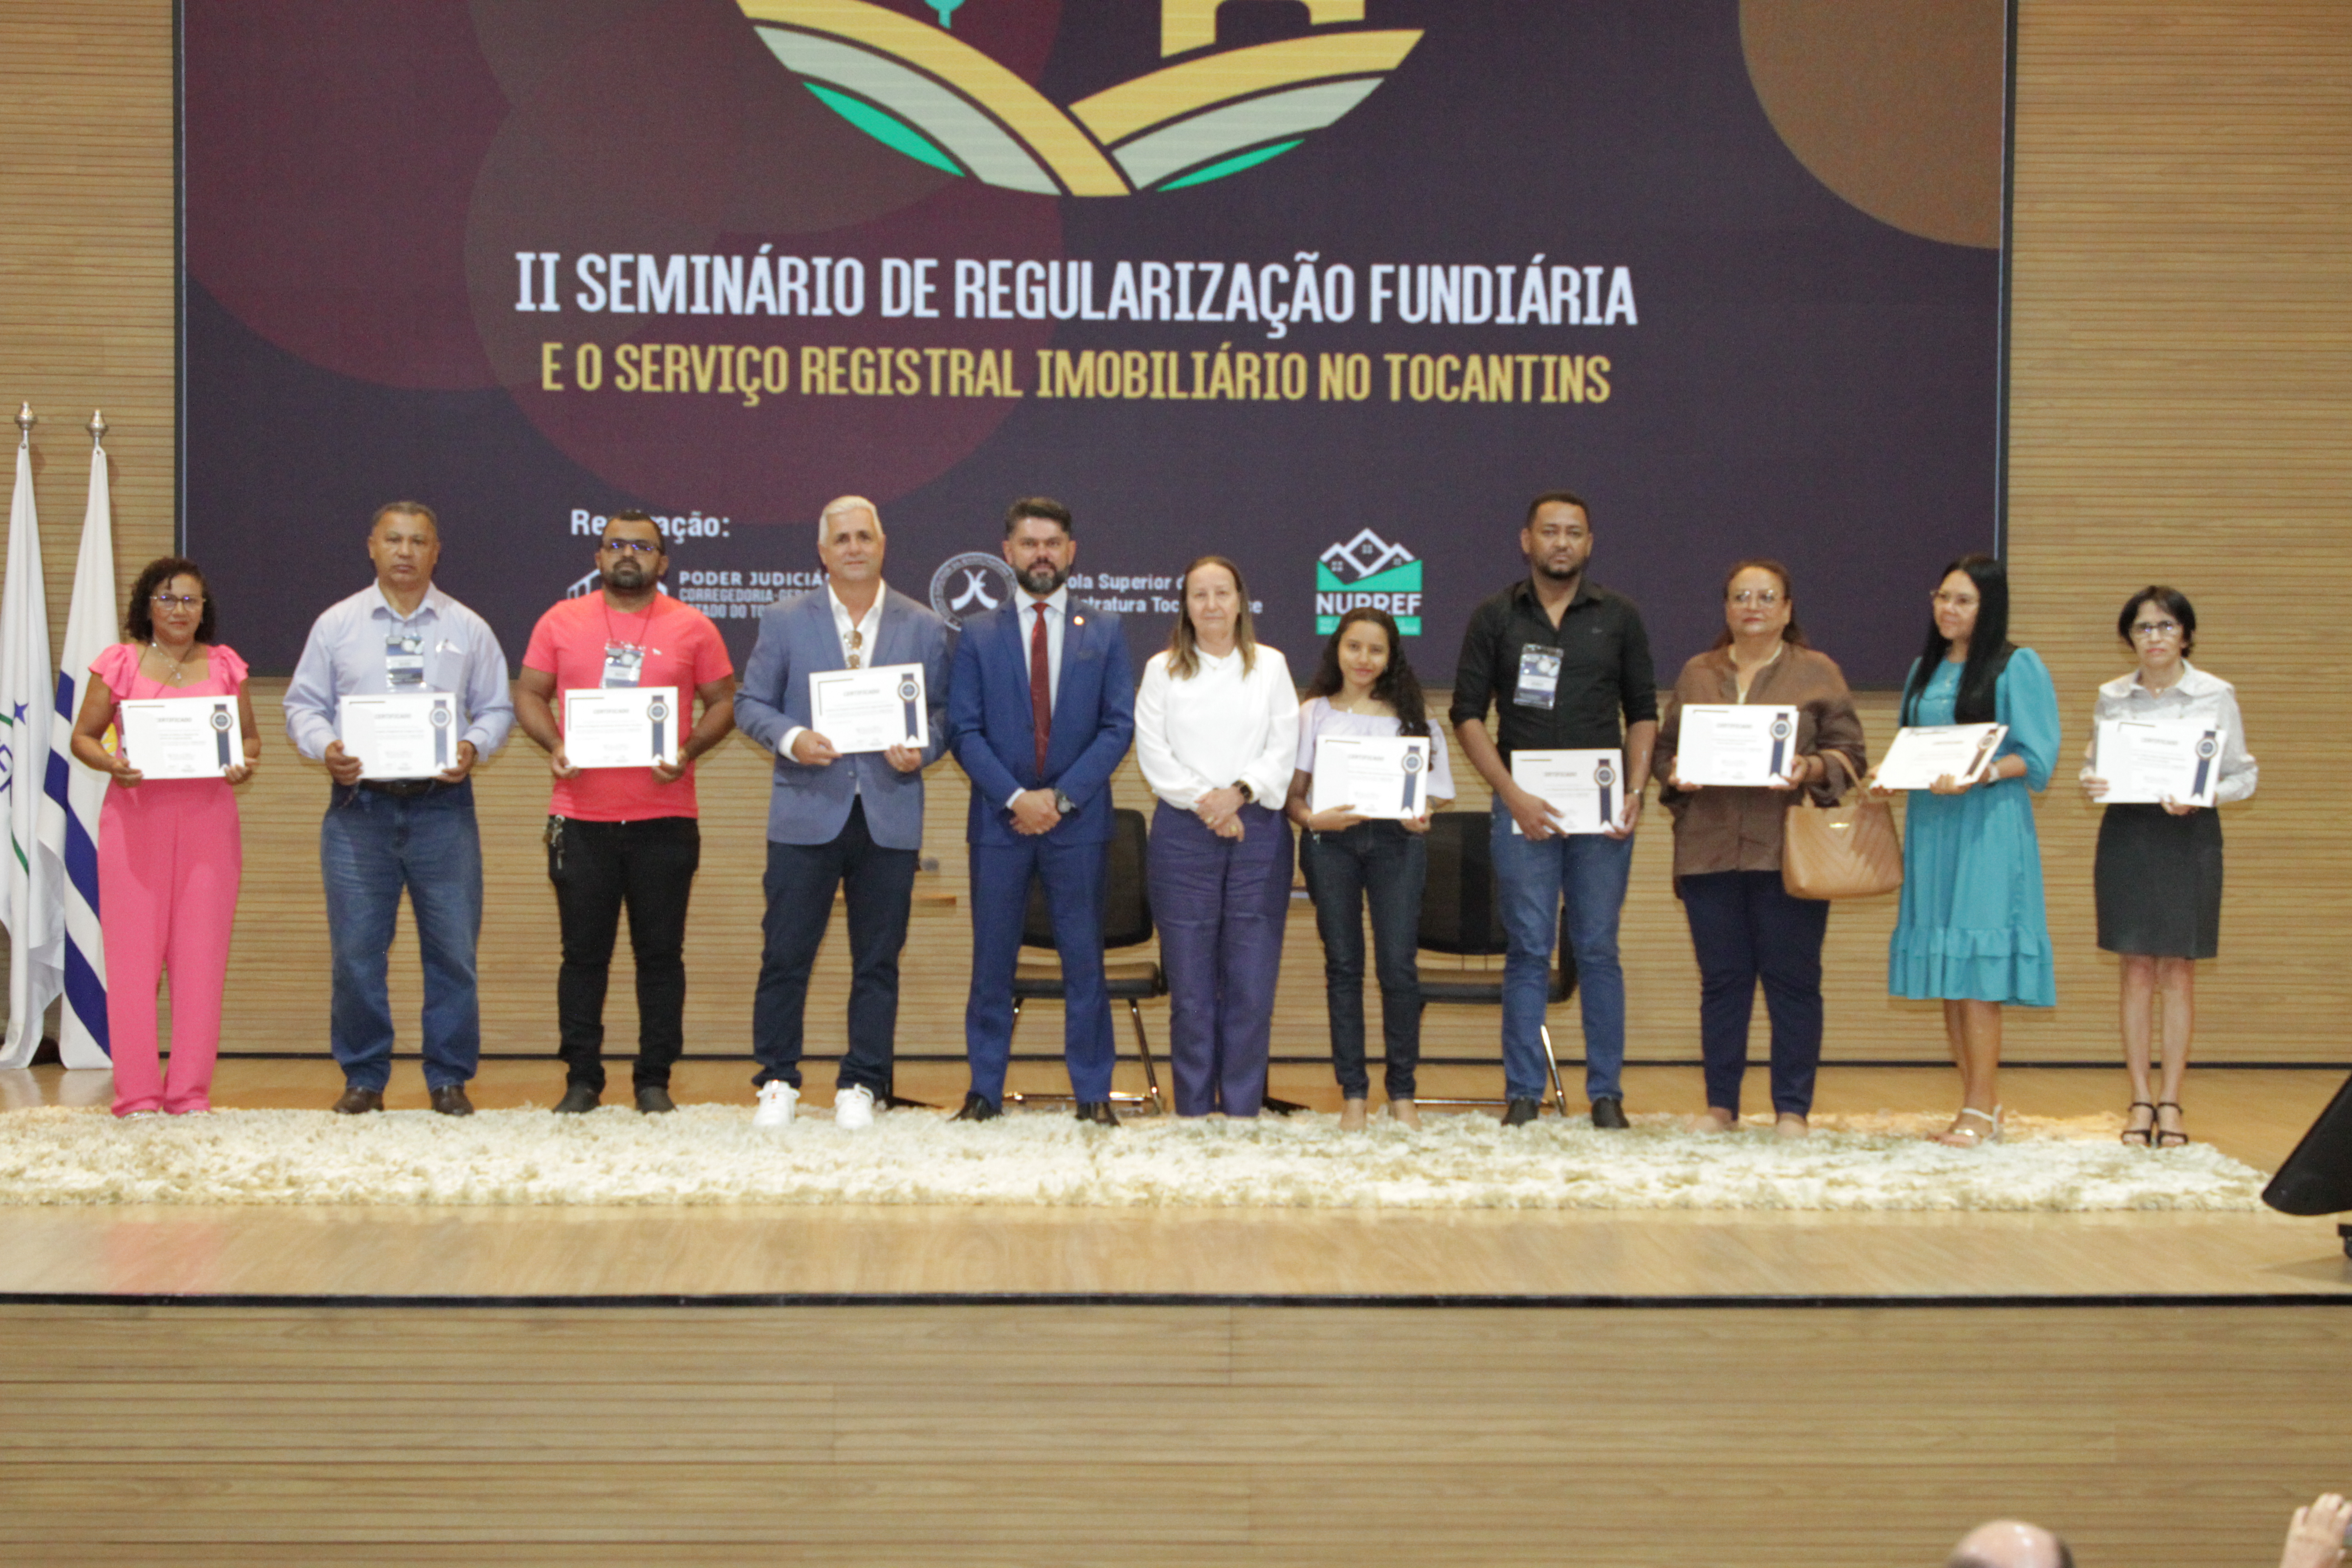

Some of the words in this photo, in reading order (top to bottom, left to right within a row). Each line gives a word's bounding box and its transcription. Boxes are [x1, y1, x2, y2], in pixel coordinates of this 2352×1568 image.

[515, 252, 560, 312] II
[576, 244, 864, 316] SEMINÁRIO
[881, 258, 939, 318] DE
[955, 252, 1354, 338] REGULARIZAÇÃO
[1370, 253, 1637, 325] FUNDIÁRIA
[542, 343, 563, 391] E
[576, 343, 602, 391] O
[615, 343, 789, 407] SERVIÇO
[801, 346, 1023, 397] REGISTRAL
[1037, 342, 1307, 400] IMOBILIÁRIO
[1319, 353, 1370, 401] NO
[1384, 353, 1611, 403] TOCANTINS
[570, 509, 730, 544] Reação:
[679, 571, 742, 586] PODER
[750, 568, 830, 587] JUDICIÁ
[1064, 573, 1093, 589] ola
[1098, 573, 1172, 593] Superior
[1316, 592, 1423, 615] NUPREF
